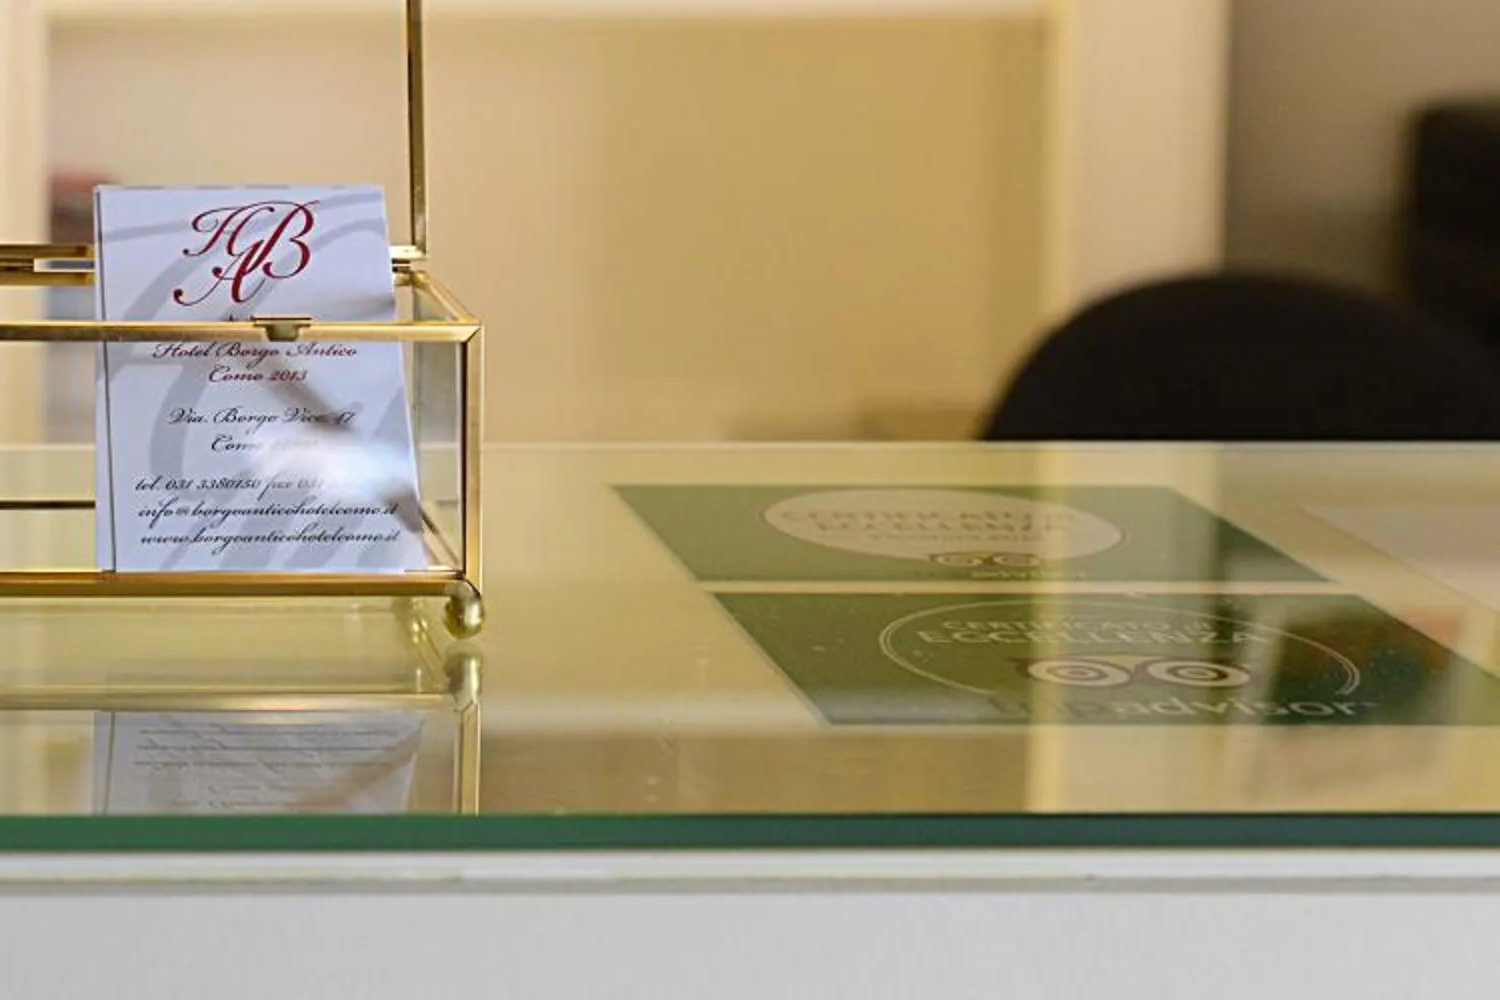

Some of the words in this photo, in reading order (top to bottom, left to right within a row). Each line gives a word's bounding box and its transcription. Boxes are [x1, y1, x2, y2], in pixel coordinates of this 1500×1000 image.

[152, 341, 209, 359] Hotel
[215, 341, 279, 369] Borgo
[285, 342, 358, 358] Antico
[208, 364, 263, 383] Como
[269, 369, 307, 382] 2013
[213, 407, 277, 435] Borgo
[211, 433, 262, 452] Com
